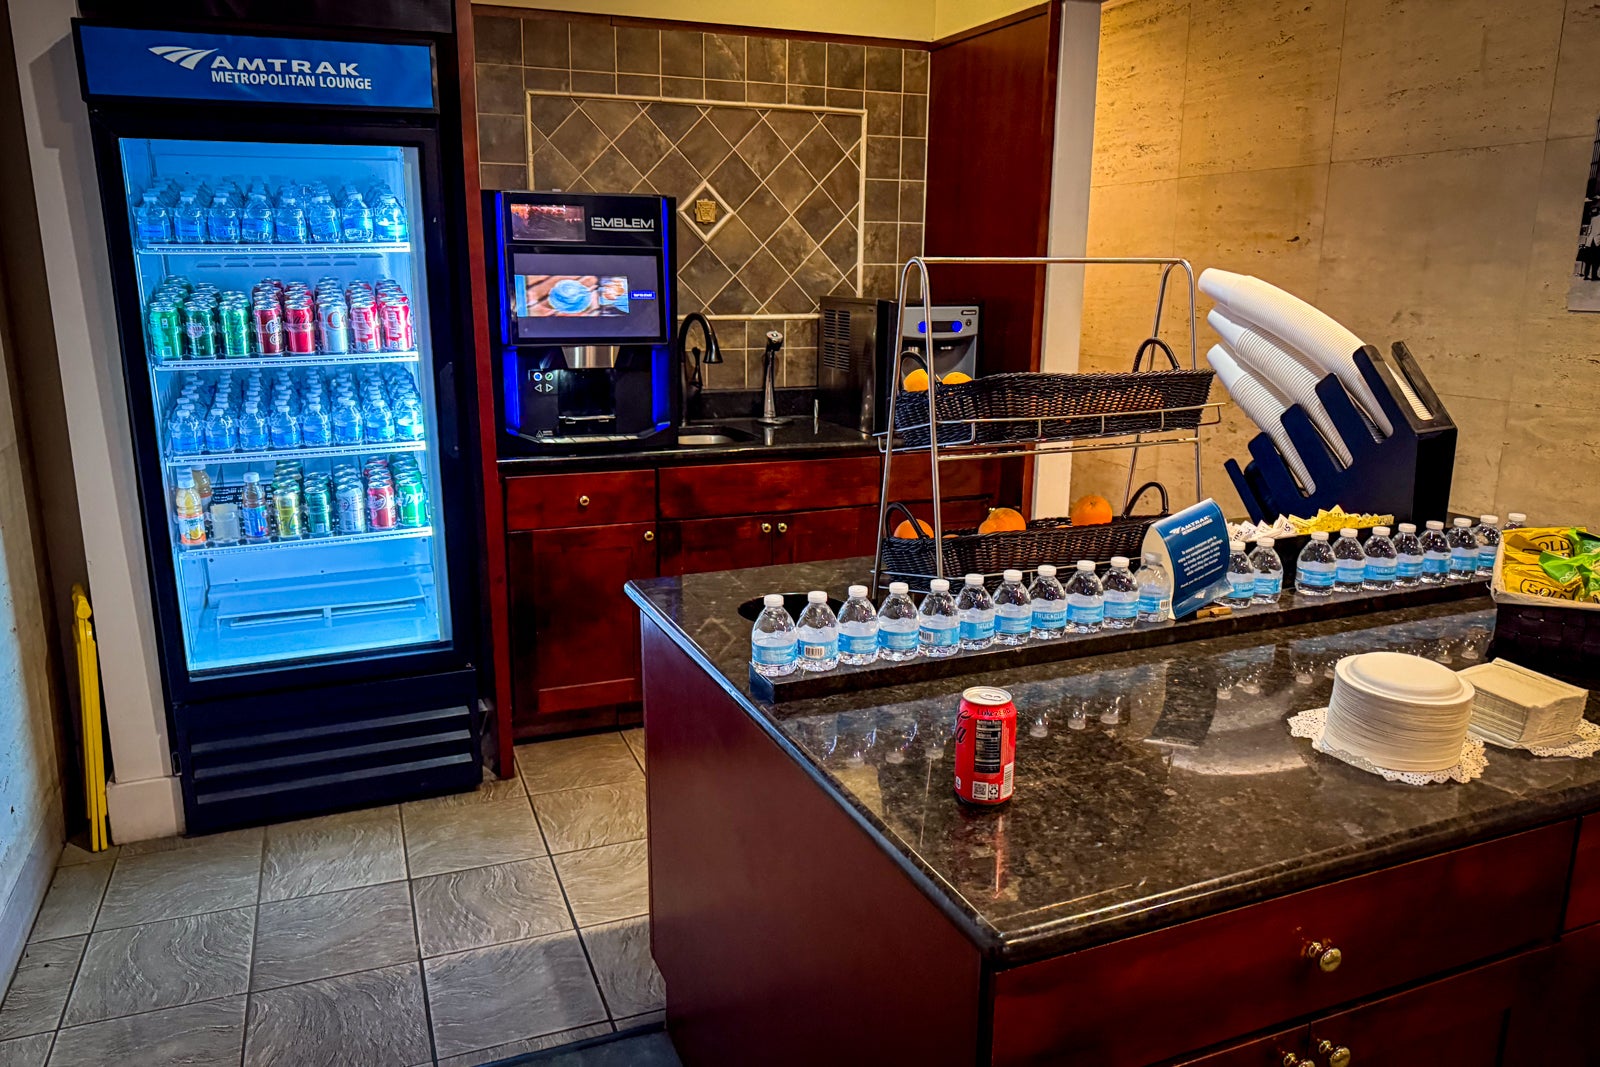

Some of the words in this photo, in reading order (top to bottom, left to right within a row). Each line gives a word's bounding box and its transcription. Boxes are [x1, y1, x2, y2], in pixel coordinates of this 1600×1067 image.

[210, 56, 360, 76] AMTRAK
[211, 70, 316, 87] METROPOLITAN
[319, 76, 372, 90] LOUNGE
[590, 216, 655, 229] EMBLEM
[1181, 515, 1211, 531] AMTRAK
[1538, 541, 1570, 551] OLD
